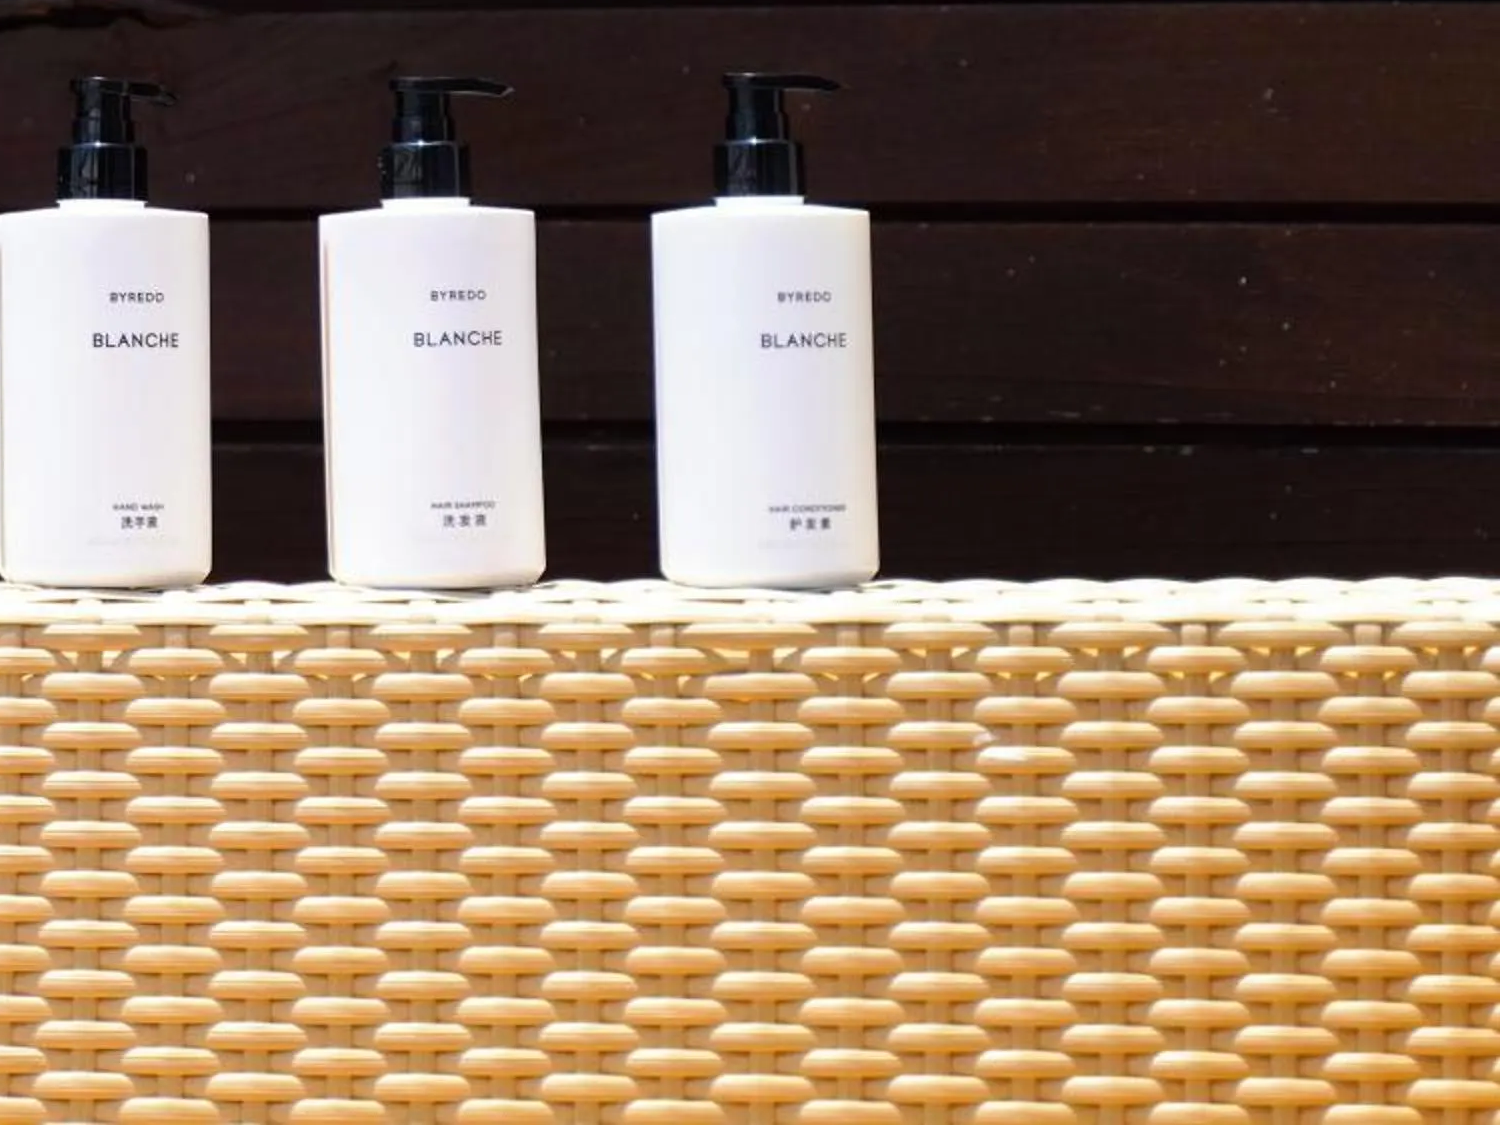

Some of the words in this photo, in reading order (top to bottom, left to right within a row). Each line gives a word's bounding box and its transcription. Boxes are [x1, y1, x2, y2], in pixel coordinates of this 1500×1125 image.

[109, 291, 165, 303] BYREDO
[430, 289, 487, 302] BYREDO
[777, 290, 832, 303] BYREDO
[92, 332, 179, 348] BLANCHE
[413, 330, 502, 347] BLANCHE
[761, 332, 846, 348] BLANCHE
